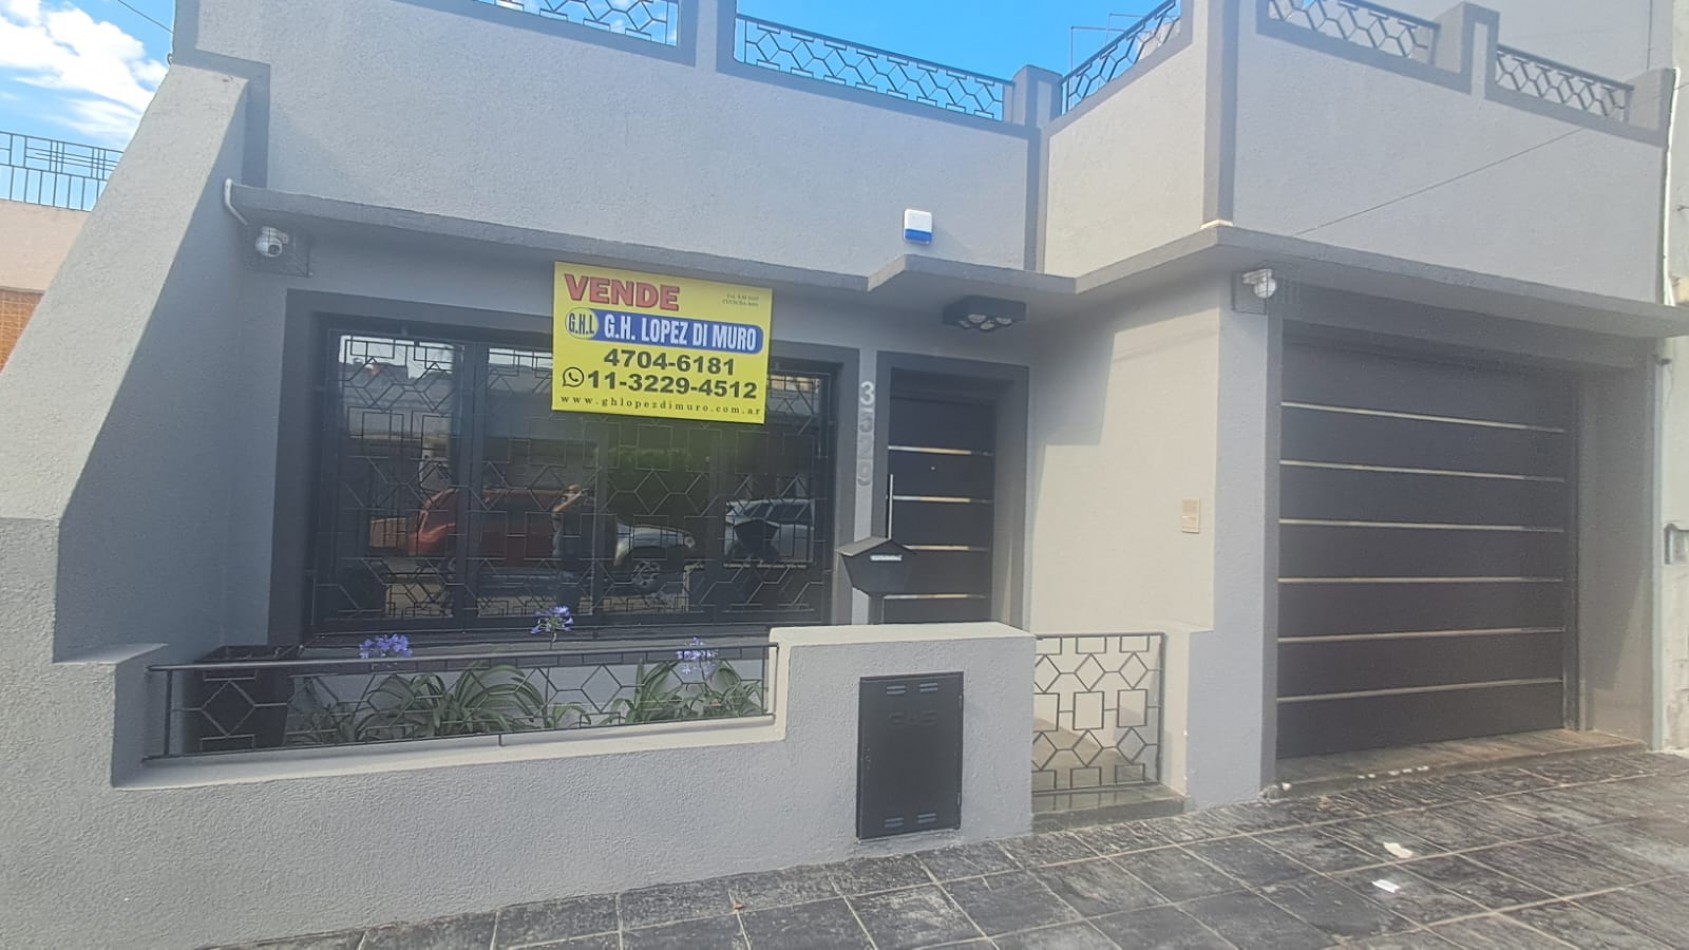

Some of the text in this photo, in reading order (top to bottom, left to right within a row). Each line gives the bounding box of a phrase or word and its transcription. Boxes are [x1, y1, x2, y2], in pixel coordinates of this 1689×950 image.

[564, 273, 680, 312] VENDE
[604, 314, 756, 351] G.H. LOPEZ DI MURO
[604, 348, 735, 376] 4704-6181
[588, 370, 757, 399] 11-3229-4512
[560, 395, 761, 416] www.ghlopezdimuro.com.ar
